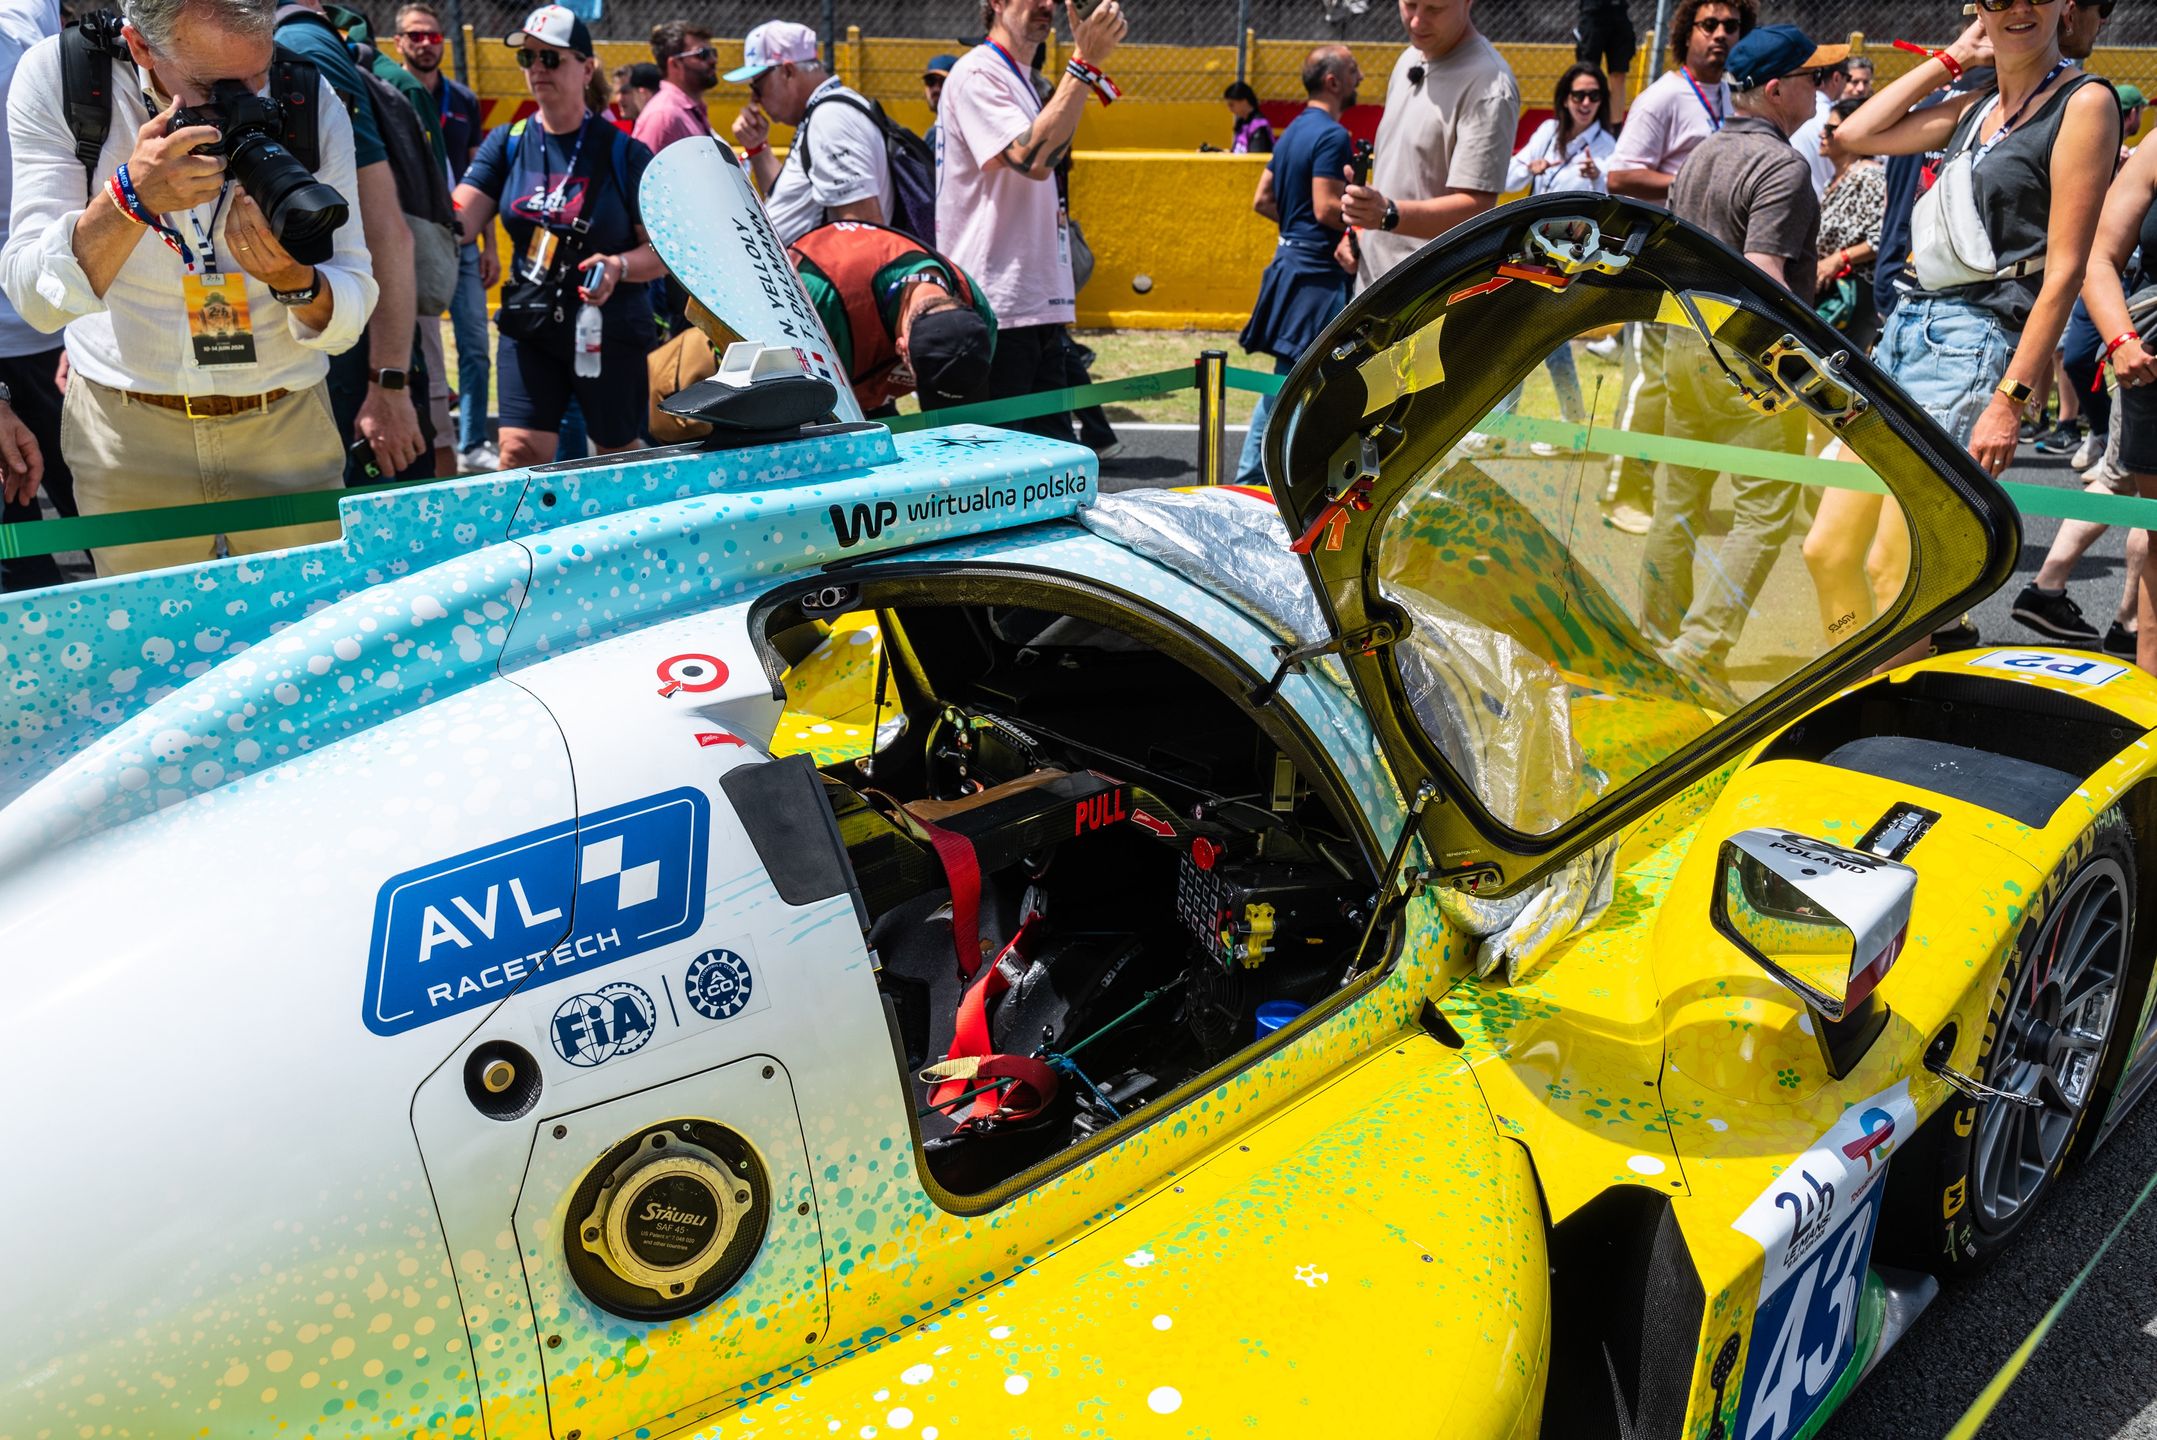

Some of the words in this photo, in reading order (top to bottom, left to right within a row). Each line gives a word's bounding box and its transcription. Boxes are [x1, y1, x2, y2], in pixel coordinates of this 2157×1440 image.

[732, 217, 785, 309] YELLOLY
[746, 207, 805, 319] DILLMANN
[779, 320, 798, 339] N.
[829, 501, 898, 548] WP
[907, 486, 1016, 522] wirtualna
[1023, 472, 1086, 509] polska
[2003, 654, 2097, 676] P2
[984, 713, 1039, 746] COSWORTH
[1075, 788, 1126, 836] PULL
[1769, 842, 1867, 874] POLAND
[418, 877, 563, 964] AVL
[426, 928, 622, 1008] RACETECH
[656, 1222, 674, 1232] SAF
[674, 1225, 685, 1234] 45
[1783, 1243, 1799, 1267] LE
[1798, 1212, 1831, 1252] MANS
[1745, 1200, 1873, 1440] 43
